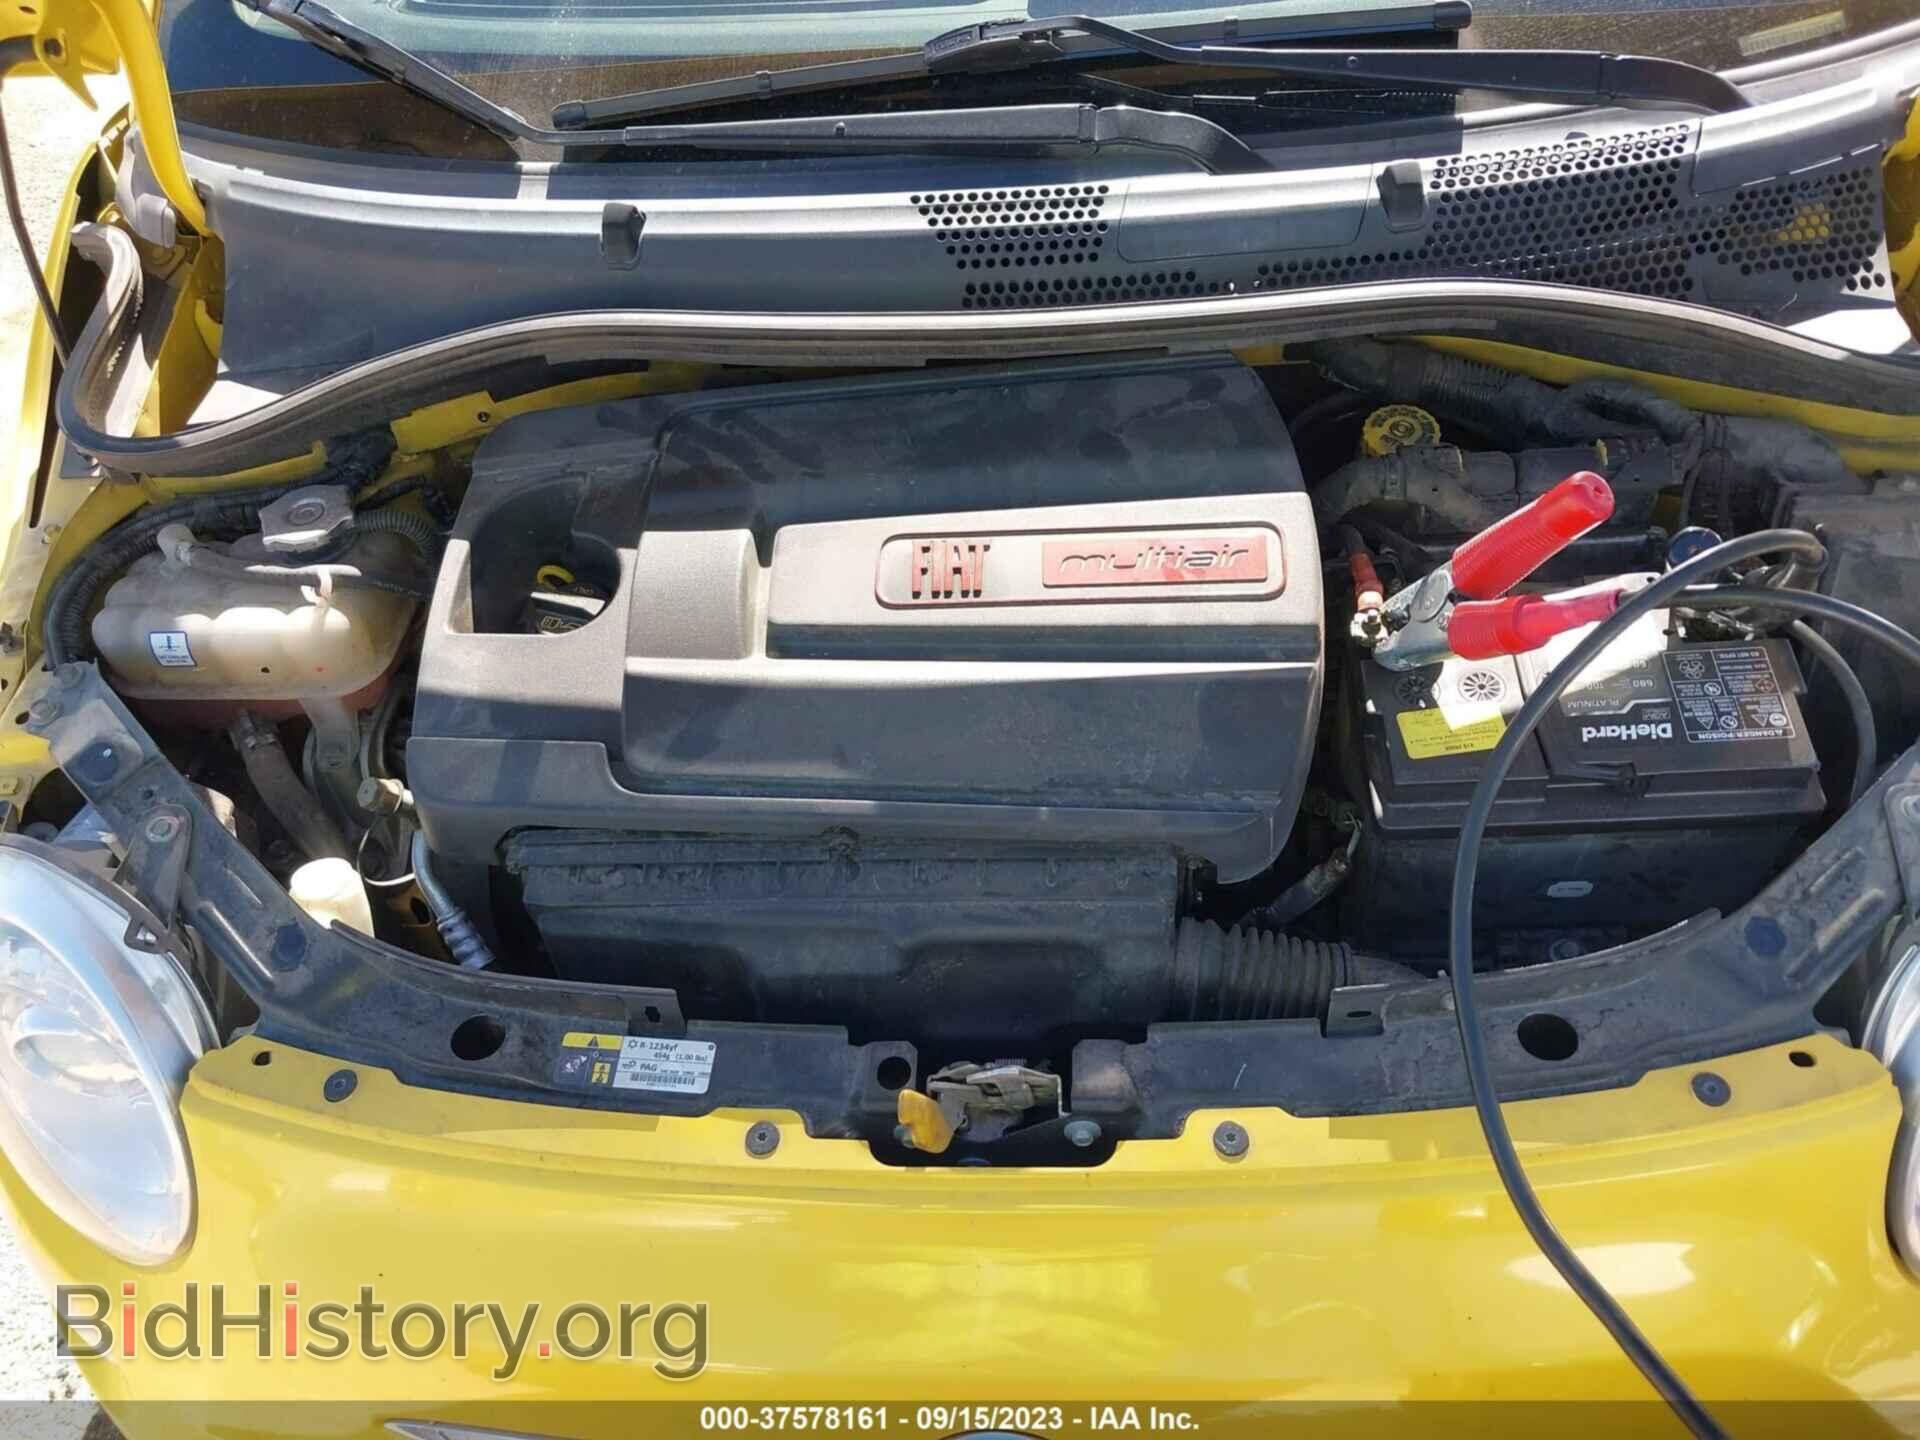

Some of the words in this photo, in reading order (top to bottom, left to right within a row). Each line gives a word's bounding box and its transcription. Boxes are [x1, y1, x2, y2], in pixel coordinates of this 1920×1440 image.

[1058, 543, 1250, 574] multiair
[911, 539, 992, 600] FIAT
[1567, 698, 1620, 710] PLATINUM
[1582, 722, 1673, 743] DieHard
[640, 1063, 658, 1072] PAG
